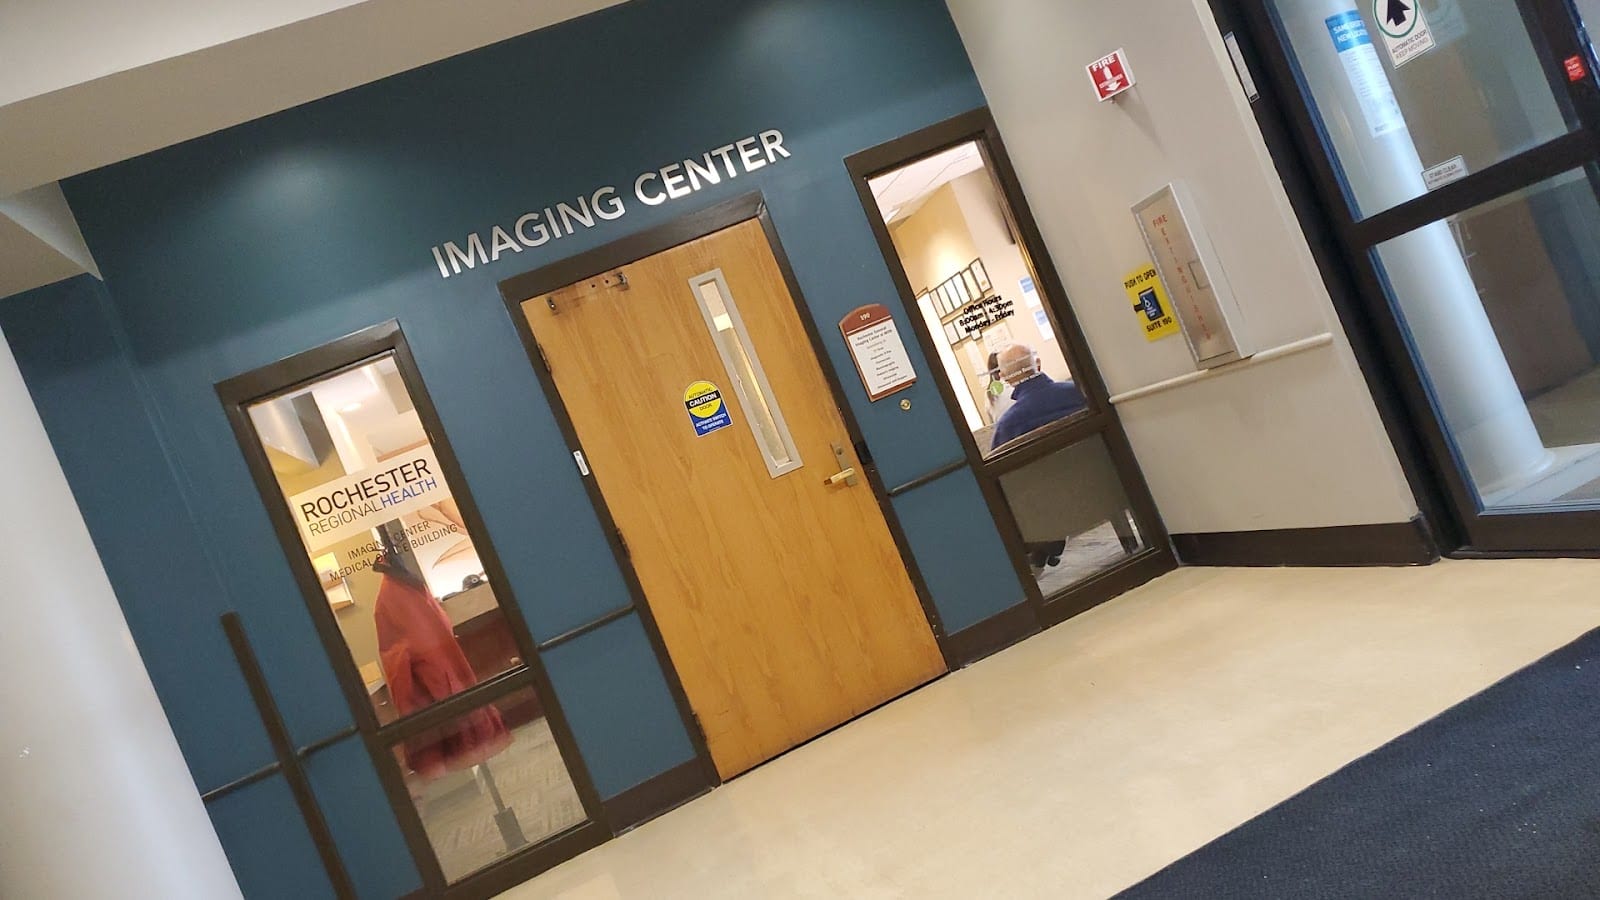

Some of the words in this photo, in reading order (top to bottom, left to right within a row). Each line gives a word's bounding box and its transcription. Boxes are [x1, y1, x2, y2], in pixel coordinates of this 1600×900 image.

[1392, 35, 1416, 53] AUTOMATIC
[1414, 29, 1427, 41] DOOR
[1396, 49, 1409, 59] KEEP
[1407, 37, 1429, 53] MOVING
[1092, 55, 1116, 72] FIRE
[431, 186, 627, 278] IMAGING
[634, 129, 791, 206] CENTER
[1153, 214, 1168, 228] FIRE
[1124, 277, 1138, 289] PUSH
[1136, 274, 1144, 284] TO
[1143, 268, 1157, 281] OPEN
[963, 303, 983, 315] Office
[982, 294, 1002, 307] Hours
[988, 300, 1014, 314] 4:30pm
[860, 312, 871, 321] 190
[964, 319, 991, 333] Monday
[994, 309, 1015, 322] Friday
[1146, 320, 1162, 333] SUITE
[1162, 317, 1173, 327] 190
[689, 388, 713, 398] AUTOMATIC
[689, 393, 717, 407] CAUTION
[300, 458, 432, 522] ROCHESTER
[393, 521, 431, 543] CENTER
[328, 557, 375, 583] MEDICAL
[411, 523, 459, 552] BUILDING
